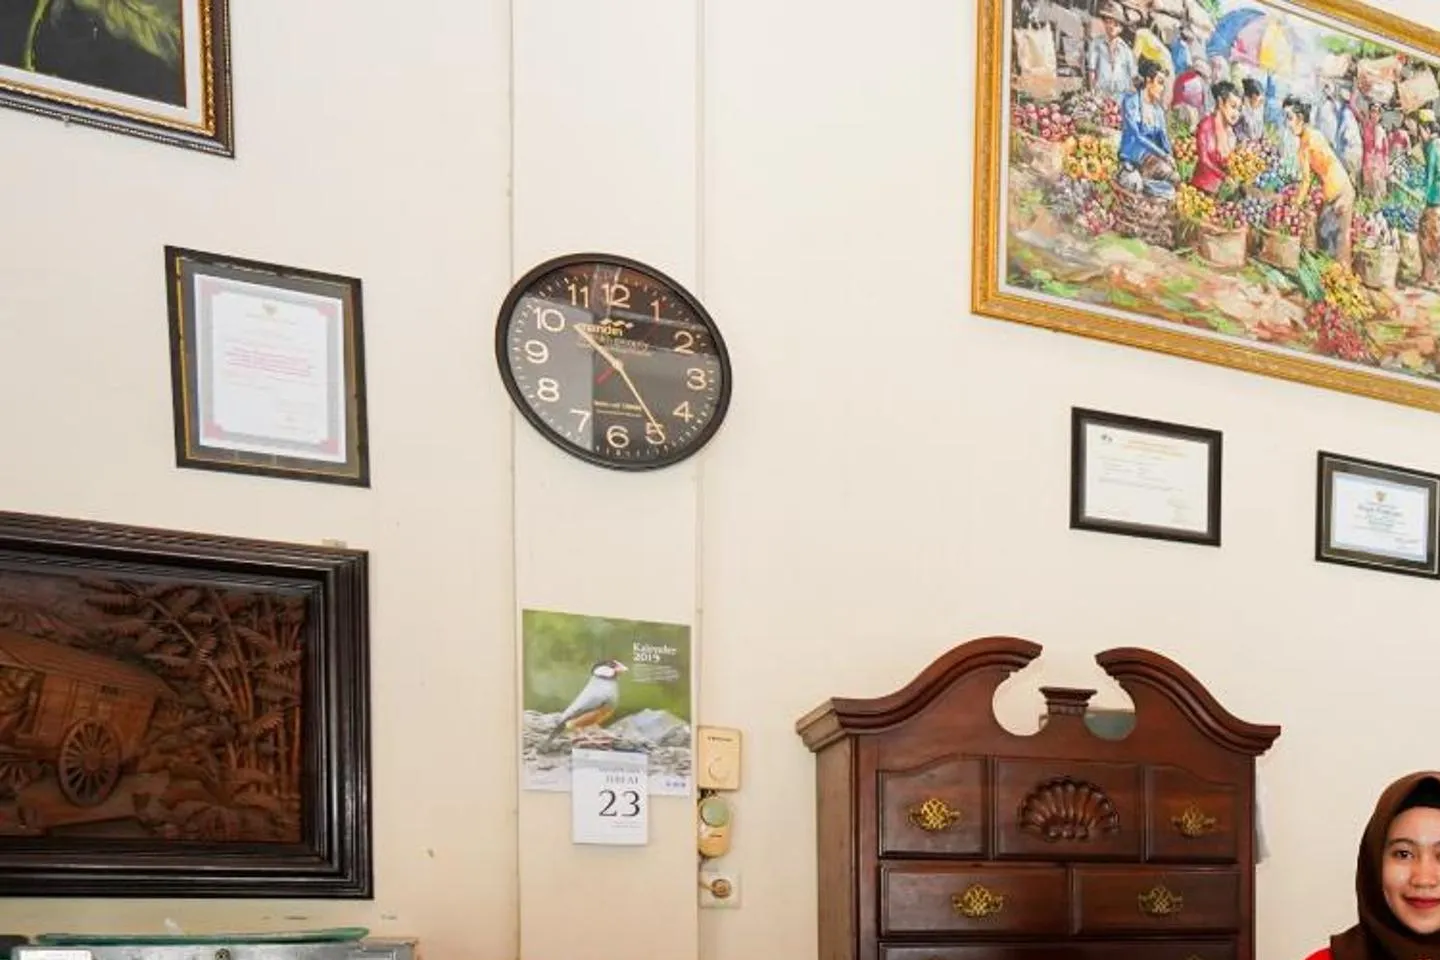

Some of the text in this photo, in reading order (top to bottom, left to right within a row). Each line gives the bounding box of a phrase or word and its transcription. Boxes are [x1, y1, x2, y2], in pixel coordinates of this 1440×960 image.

[568, 283, 590, 308] 11
[602, 283, 631, 309] 12
[532, 307, 566, 333] 10
[651, 299, 661, 322] 1
[524, 339, 549, 364] 9
[673, 330, 695, 355] 2
[536, 377, 560, 403] 8
[686, 367, 707, 391] 3
[569, 408, 592, 433] 7
[672, 400, 695, 424] 4
[606, 424, 630, 449] 6
[645, 421, 666, 445] 5
[598, 789, 641, 818] 23
